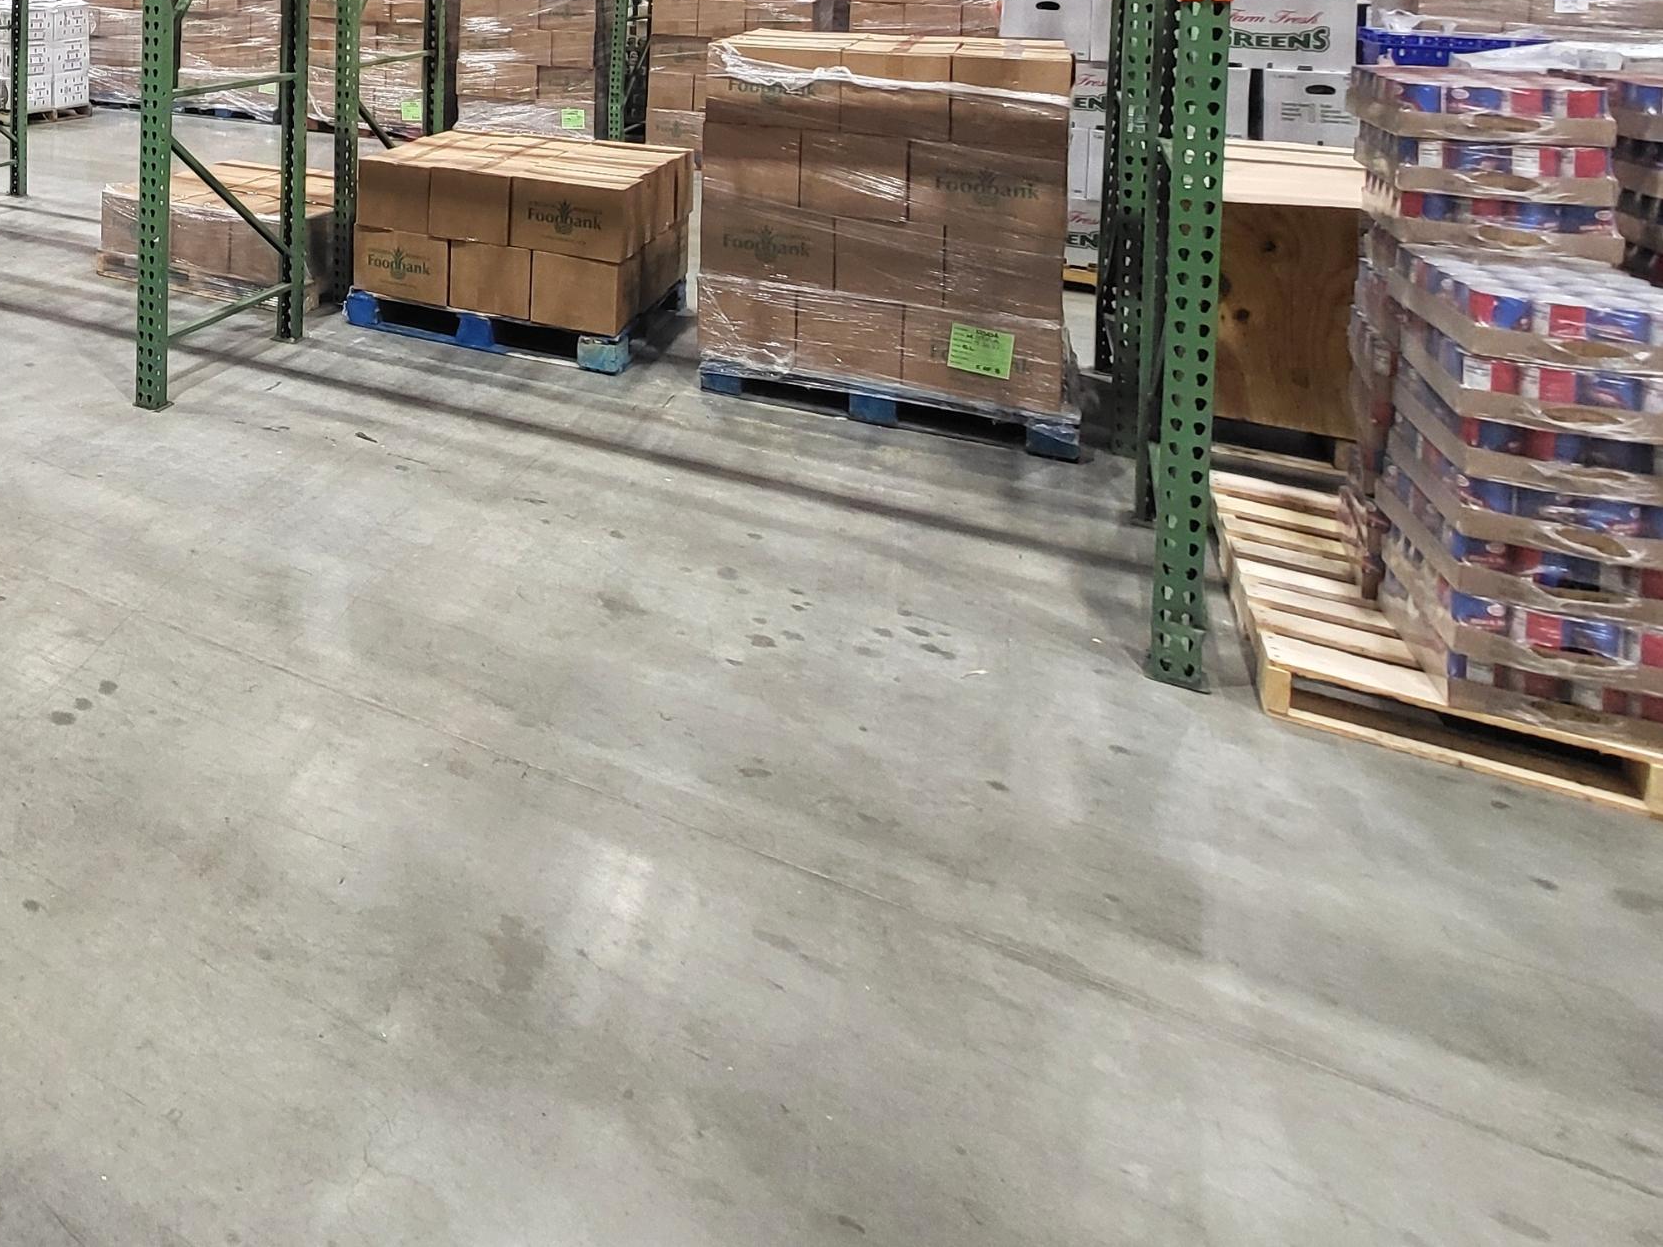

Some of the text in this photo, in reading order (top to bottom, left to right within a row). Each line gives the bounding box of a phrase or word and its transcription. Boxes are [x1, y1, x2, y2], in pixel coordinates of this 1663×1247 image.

[1269, 9, 1324, 24] Fresh
[527, 207, 602, 230] Foodbank
[367, 254, 431, 275] Foodbank
